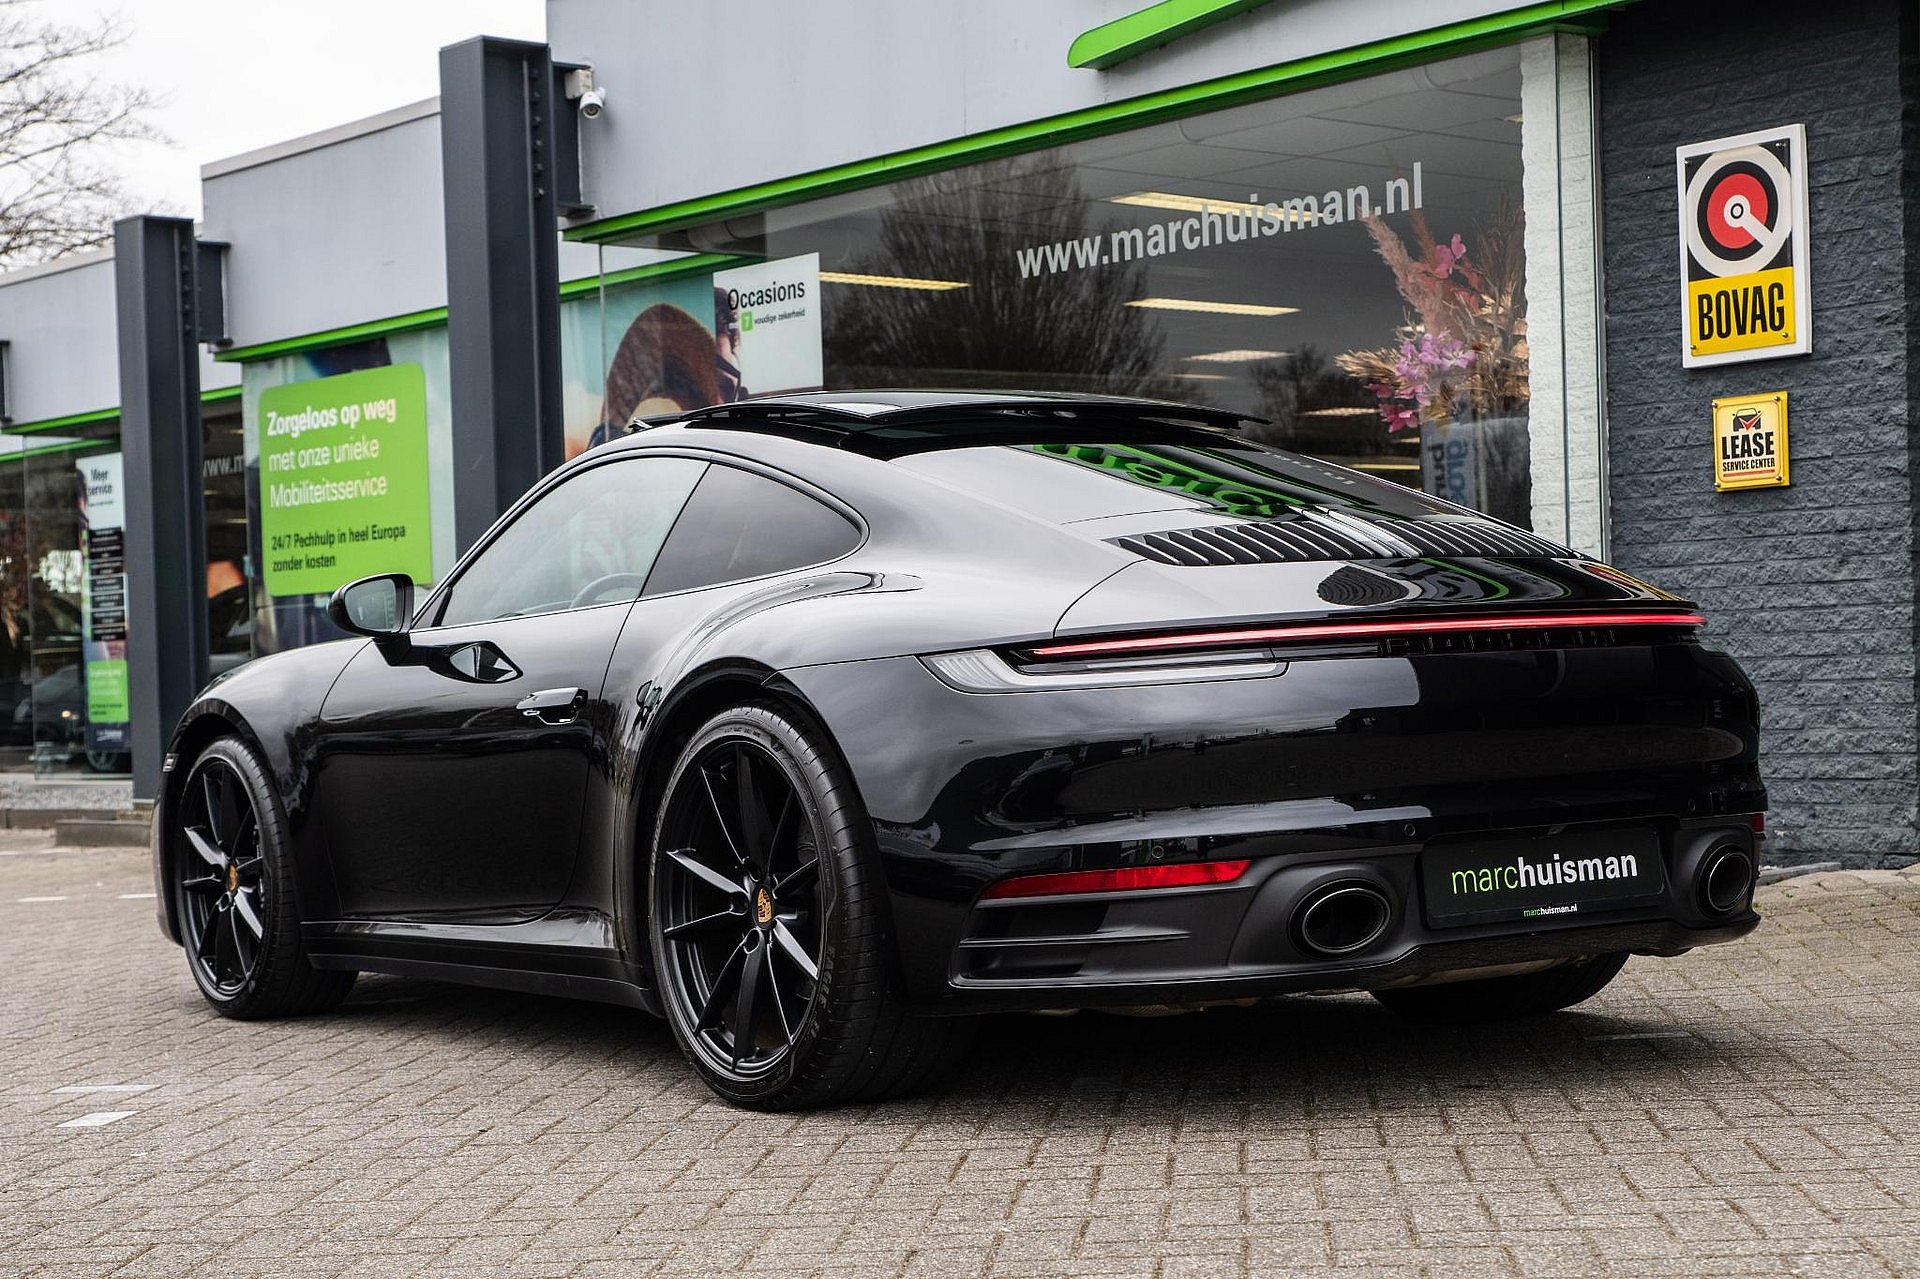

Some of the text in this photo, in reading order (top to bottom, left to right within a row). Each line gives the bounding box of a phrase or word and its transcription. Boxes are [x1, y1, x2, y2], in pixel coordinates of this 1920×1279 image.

[1017, 161, 1423, 279] www.marchuisman.nl
[728, 281, 805, 310] Occasions
[1697, 282, 1786, 341] BOVAG
[267, 398, 397, 438] Zorgeloos op weg
[268, 434, 380, 472] met onze unieke
[1721, 431, 1775, 460] LEASE
[1722, 457, 1776, 472] SERVICE CENTER
[270, 471, 388, 508] Mobiliteitsservice
[271, 523, 406, 551] 24/7 Pechhulp in heel Europa
[273, 553, 336, 572] zonder kosten
[1451, 852, 1638, 895] marchuisman
[1523, 903, 1578, 917] marchuisman.nl
